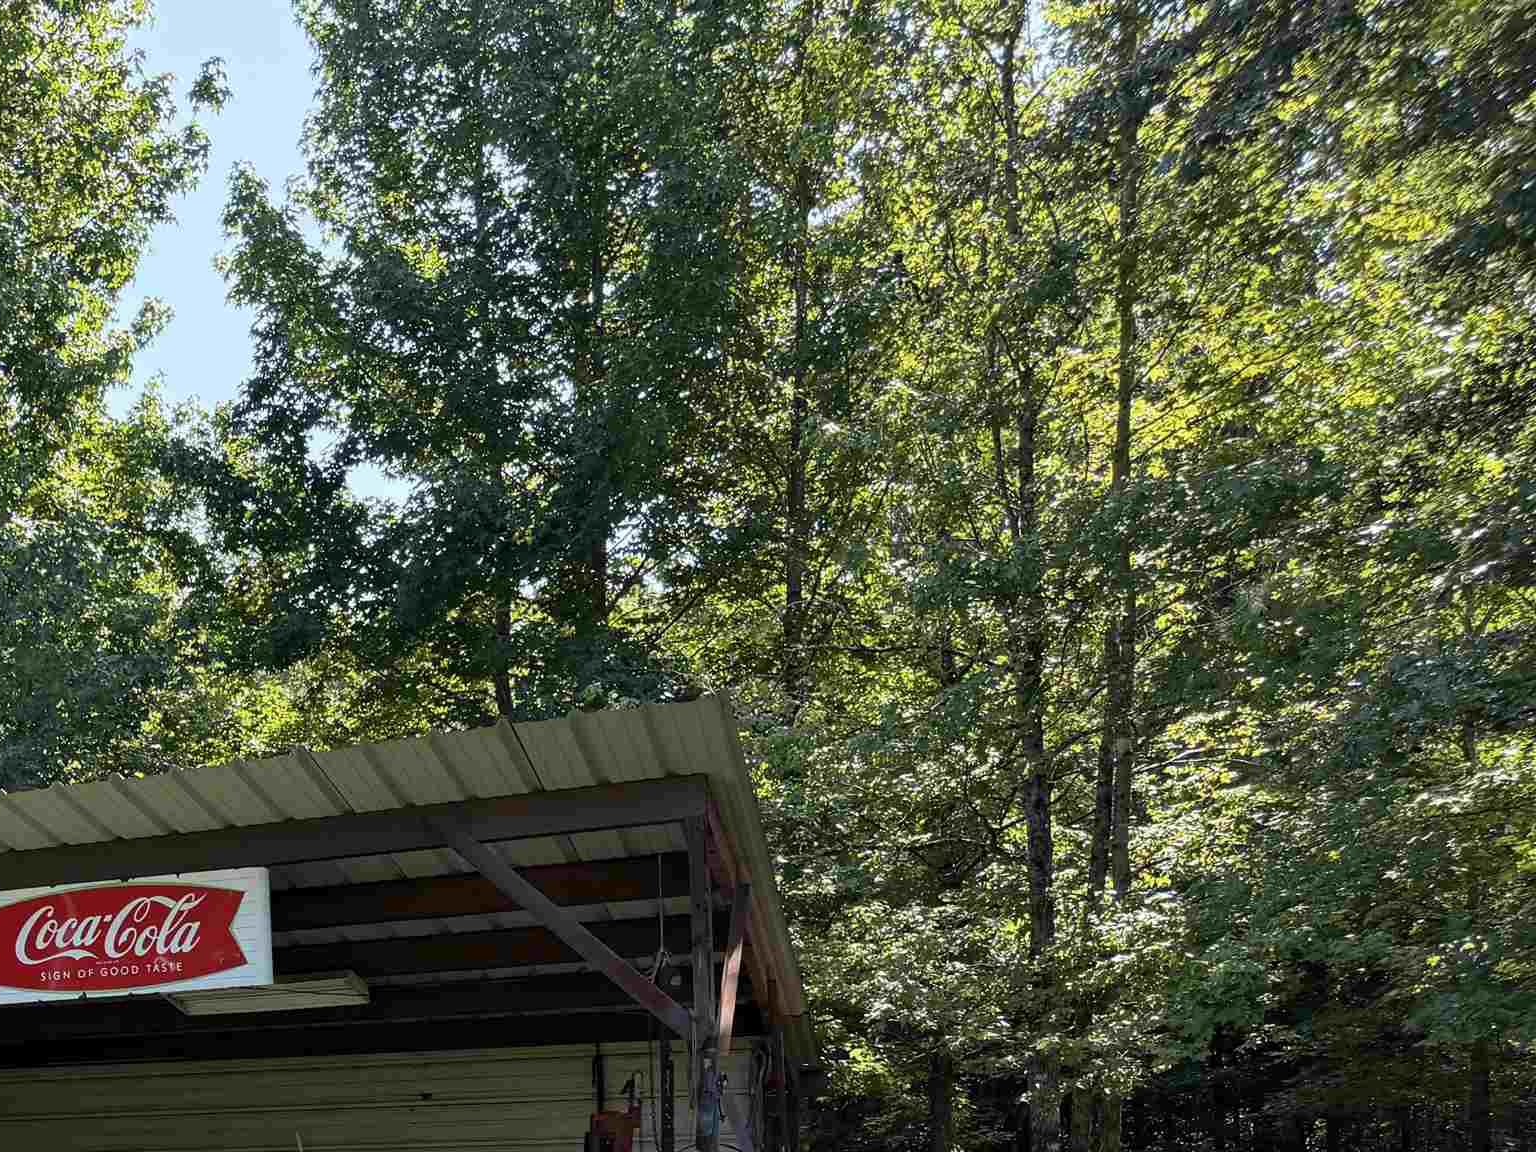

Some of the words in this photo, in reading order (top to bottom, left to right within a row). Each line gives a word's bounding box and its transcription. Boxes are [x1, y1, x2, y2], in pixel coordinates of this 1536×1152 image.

[15, 892, 208, 965] Coca-Cola
[40, 971, 71, 982] SIGN
[77, 968, 95, 979] OF
[100, 965, 140, 977] GOOD
[146, 960, 184, 974] TASTE
